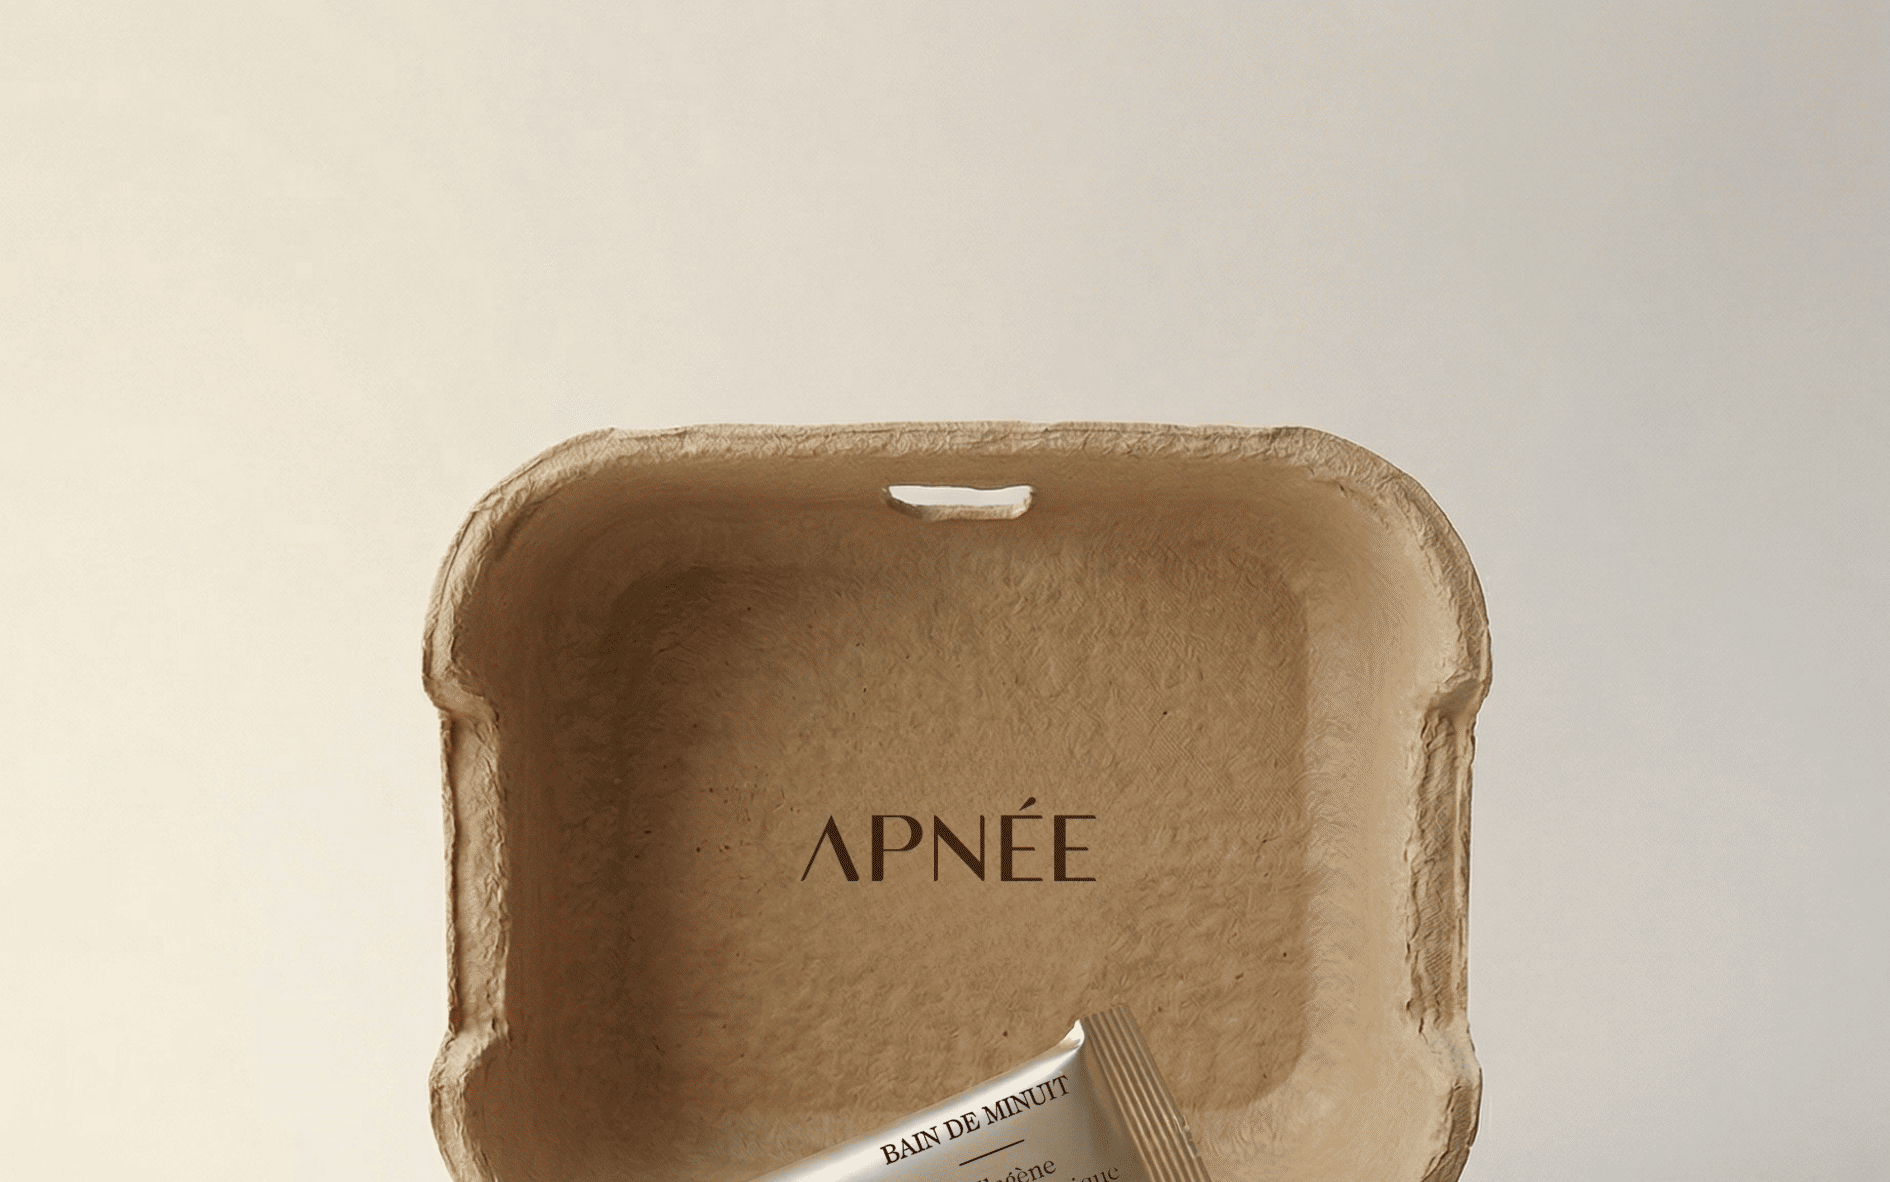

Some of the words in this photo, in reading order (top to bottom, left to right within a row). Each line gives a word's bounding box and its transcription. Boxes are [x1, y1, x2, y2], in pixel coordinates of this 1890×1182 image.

[800, 796, 1097, 882] APNÉE
[879, 1126, 941, 1165] BAIN
[943, 1111, 981, 1141] DE
[982, 1074, 1069, 1126] MINUIT
